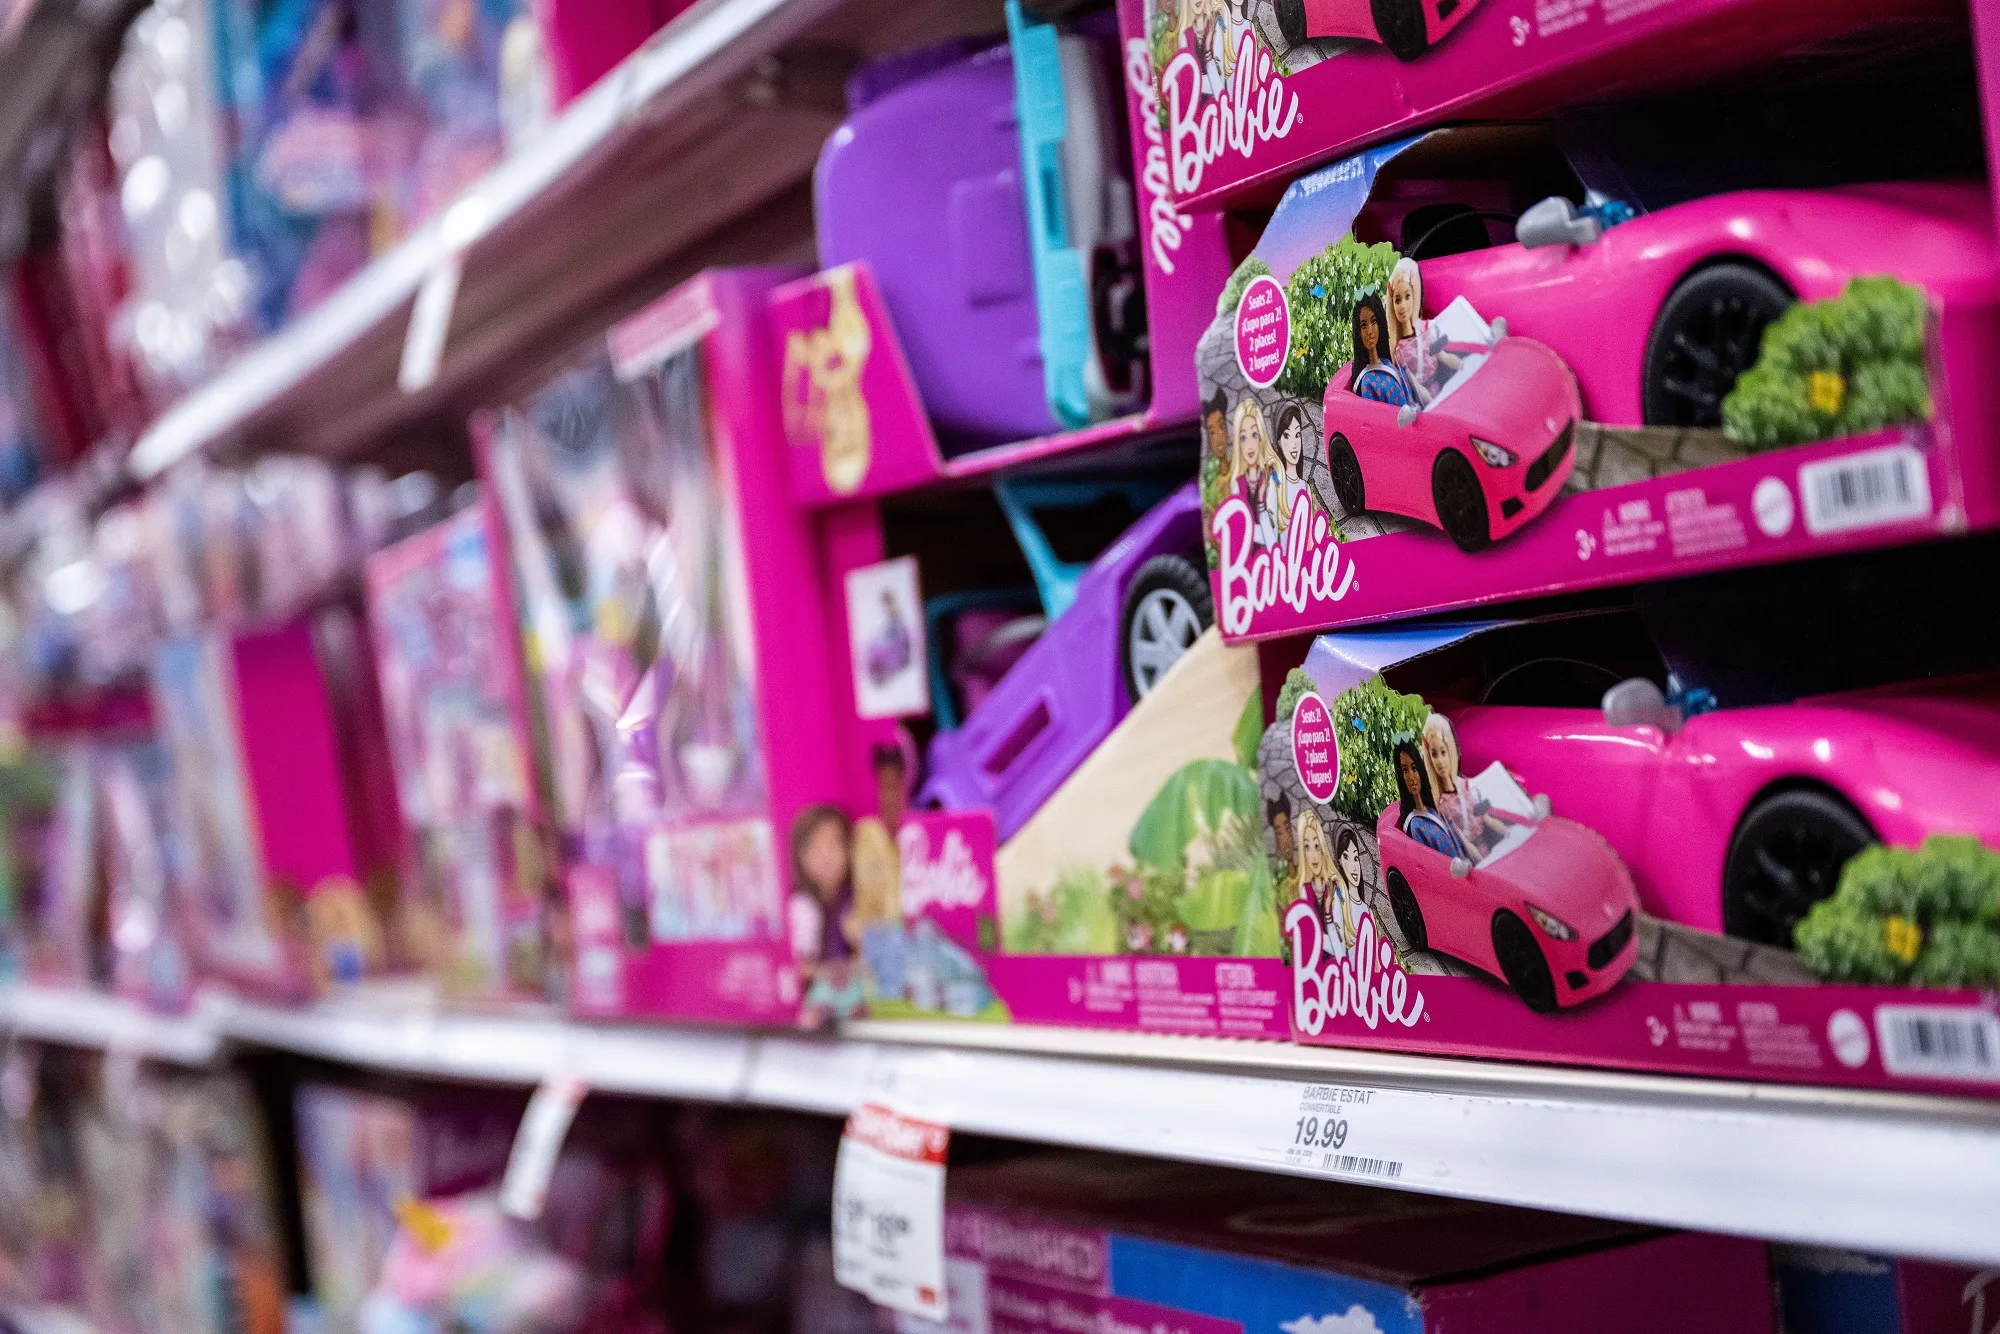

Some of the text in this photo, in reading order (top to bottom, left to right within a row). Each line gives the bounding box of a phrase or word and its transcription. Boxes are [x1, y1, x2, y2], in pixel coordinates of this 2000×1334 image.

[1162, 34, 1299, 193] Barbie
[1248, 288, 1273, 311] Seats 2!
[1260, 311, 1275, 331] para
[1275, 305, 1283, 322] 2!
[1249, 328, 1277, 353] 2 places!
[1249, 348, 1280, 372] 2 lugares!
[1213, 494, 1356, 635] Barbie
[1301, 707, 1322, 724] Seats 2!
[1312, 731, 1325, 747] para
[1324, 727, 1331, 743] 2!
[1305, 748, 1328, 768] 2 places!
[1306, 769, 1333, 788] 2 lugares!
[1285, 903, 1425, 1036] Barbie
[1302, 1086, 1339, 1102] BARBIE
[1299, 1101, 1343, 1115] CONVERTIBLE
[1295, 1115, 1348, 1150] 19.99
